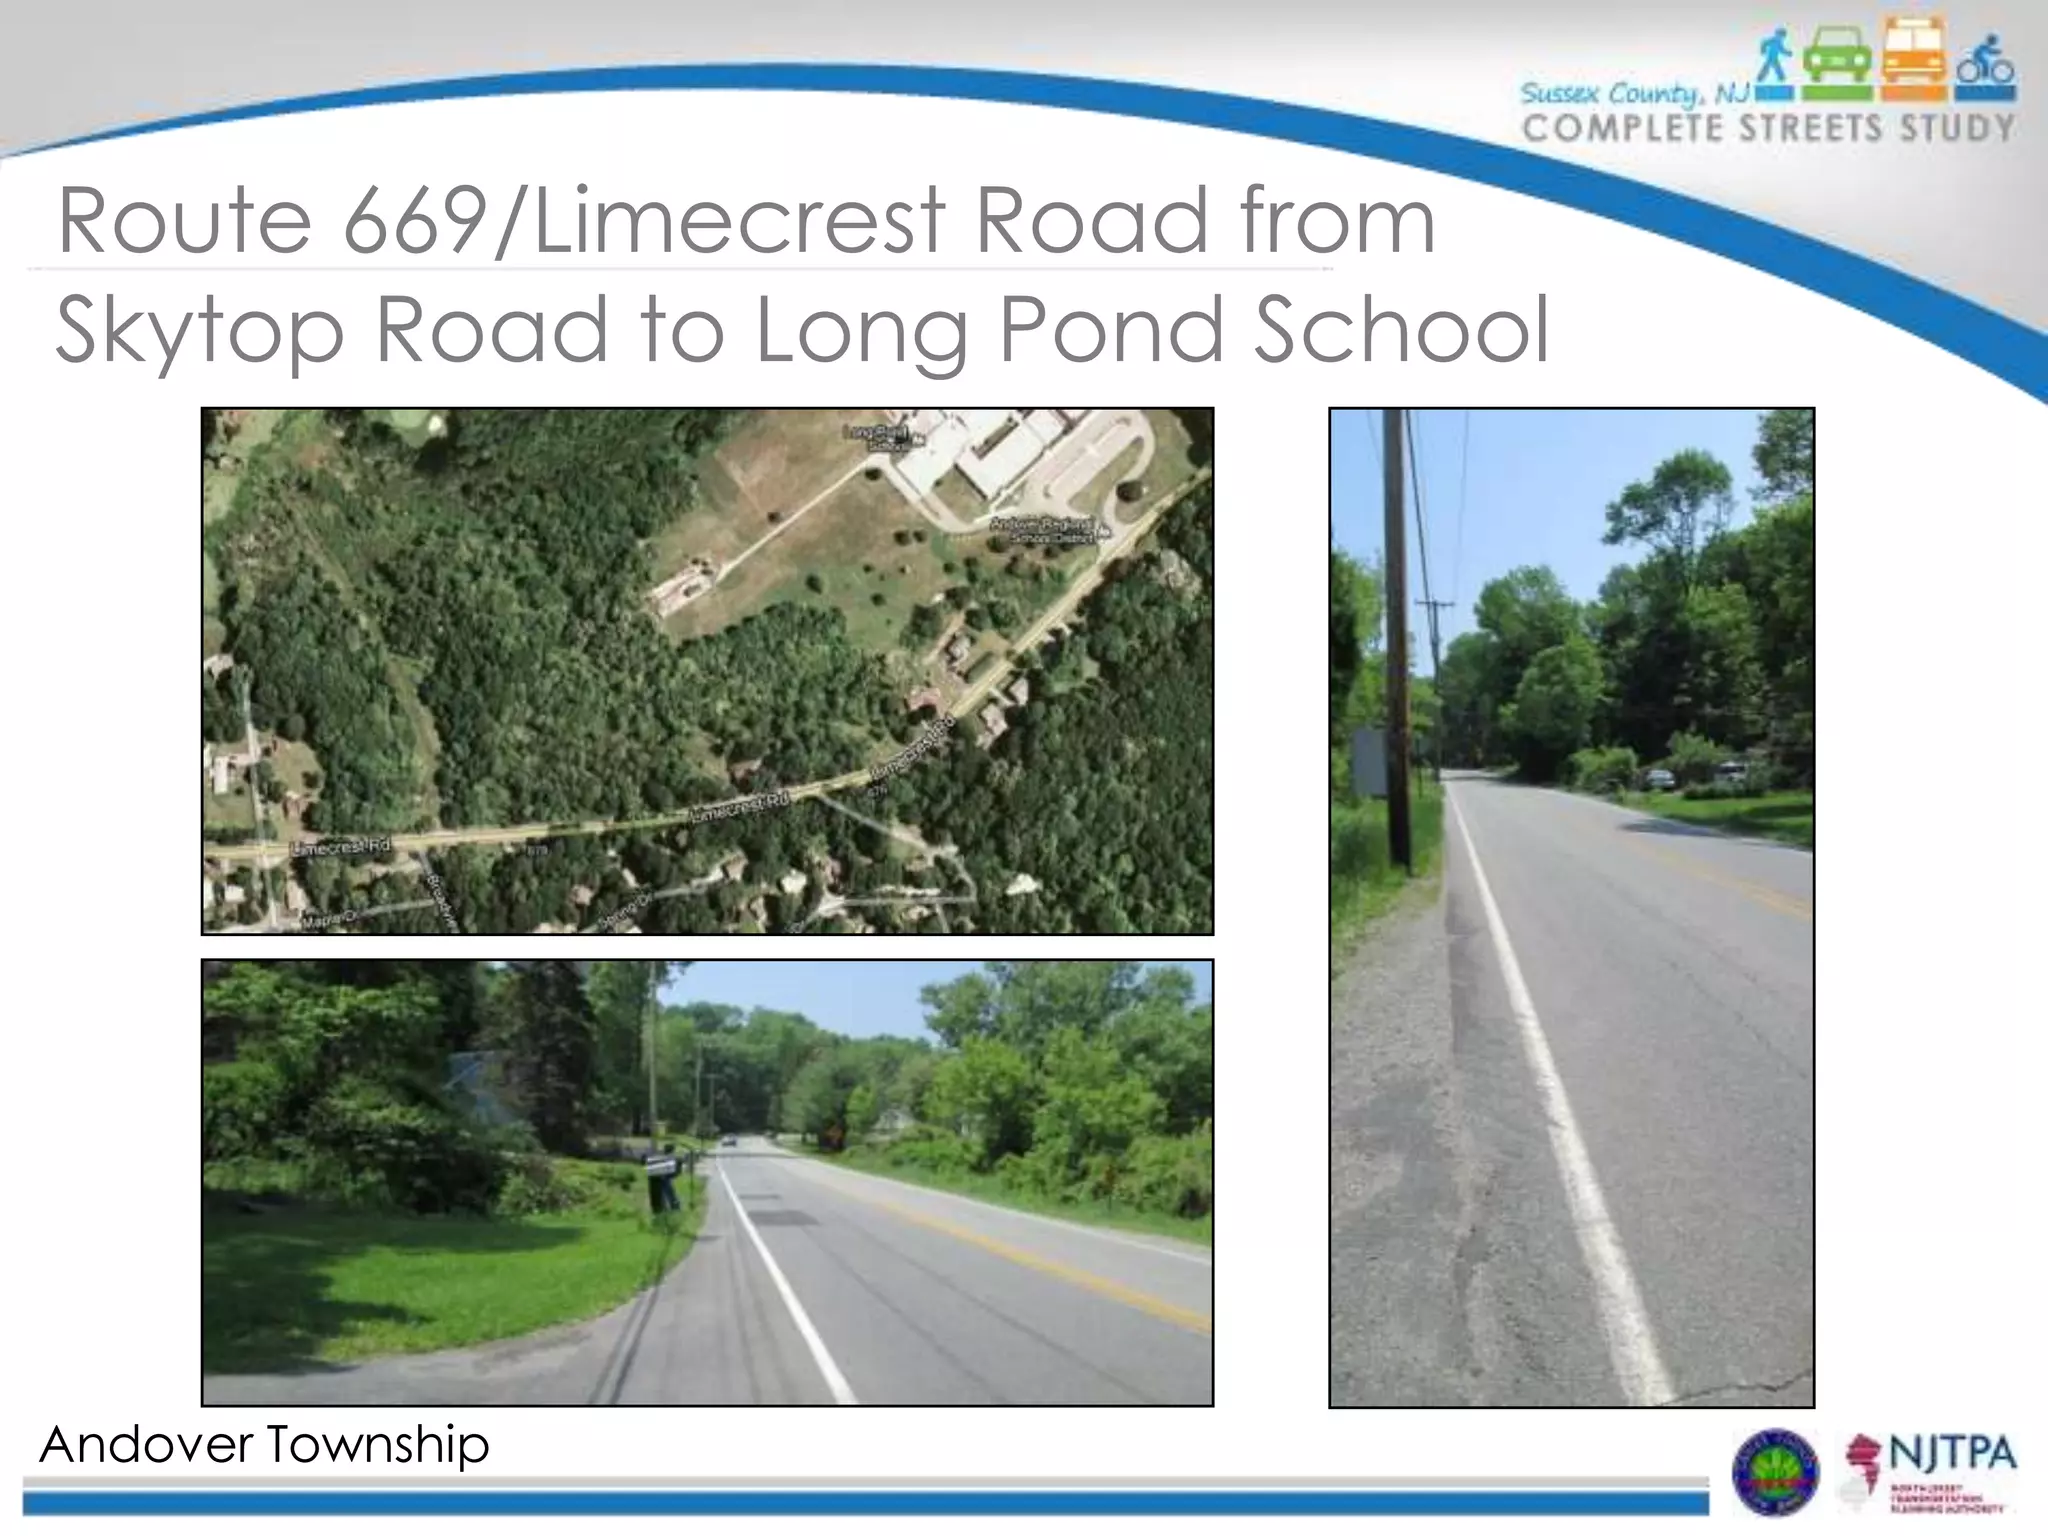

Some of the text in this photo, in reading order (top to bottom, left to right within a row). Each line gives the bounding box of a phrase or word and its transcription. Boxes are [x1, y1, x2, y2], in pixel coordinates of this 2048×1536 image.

[1521, 81, 1751, 111] Sussex County, NJ
[1523, 113, 2015, 142] COMPLETE STREETS STUDY
[61, 182, 1437, 262] Route 669/Limecrest Road from
[55, 293, 1547, 381] Skytop Road to Long Pond School
[690, 791, 789, 823] Limecrest Rd
[290, 836, 391, 857] Limecrest Rd
[38, 1422, 490, 1473] Andover Township
[1890, 1433, 2018, 1475] NJTPA
